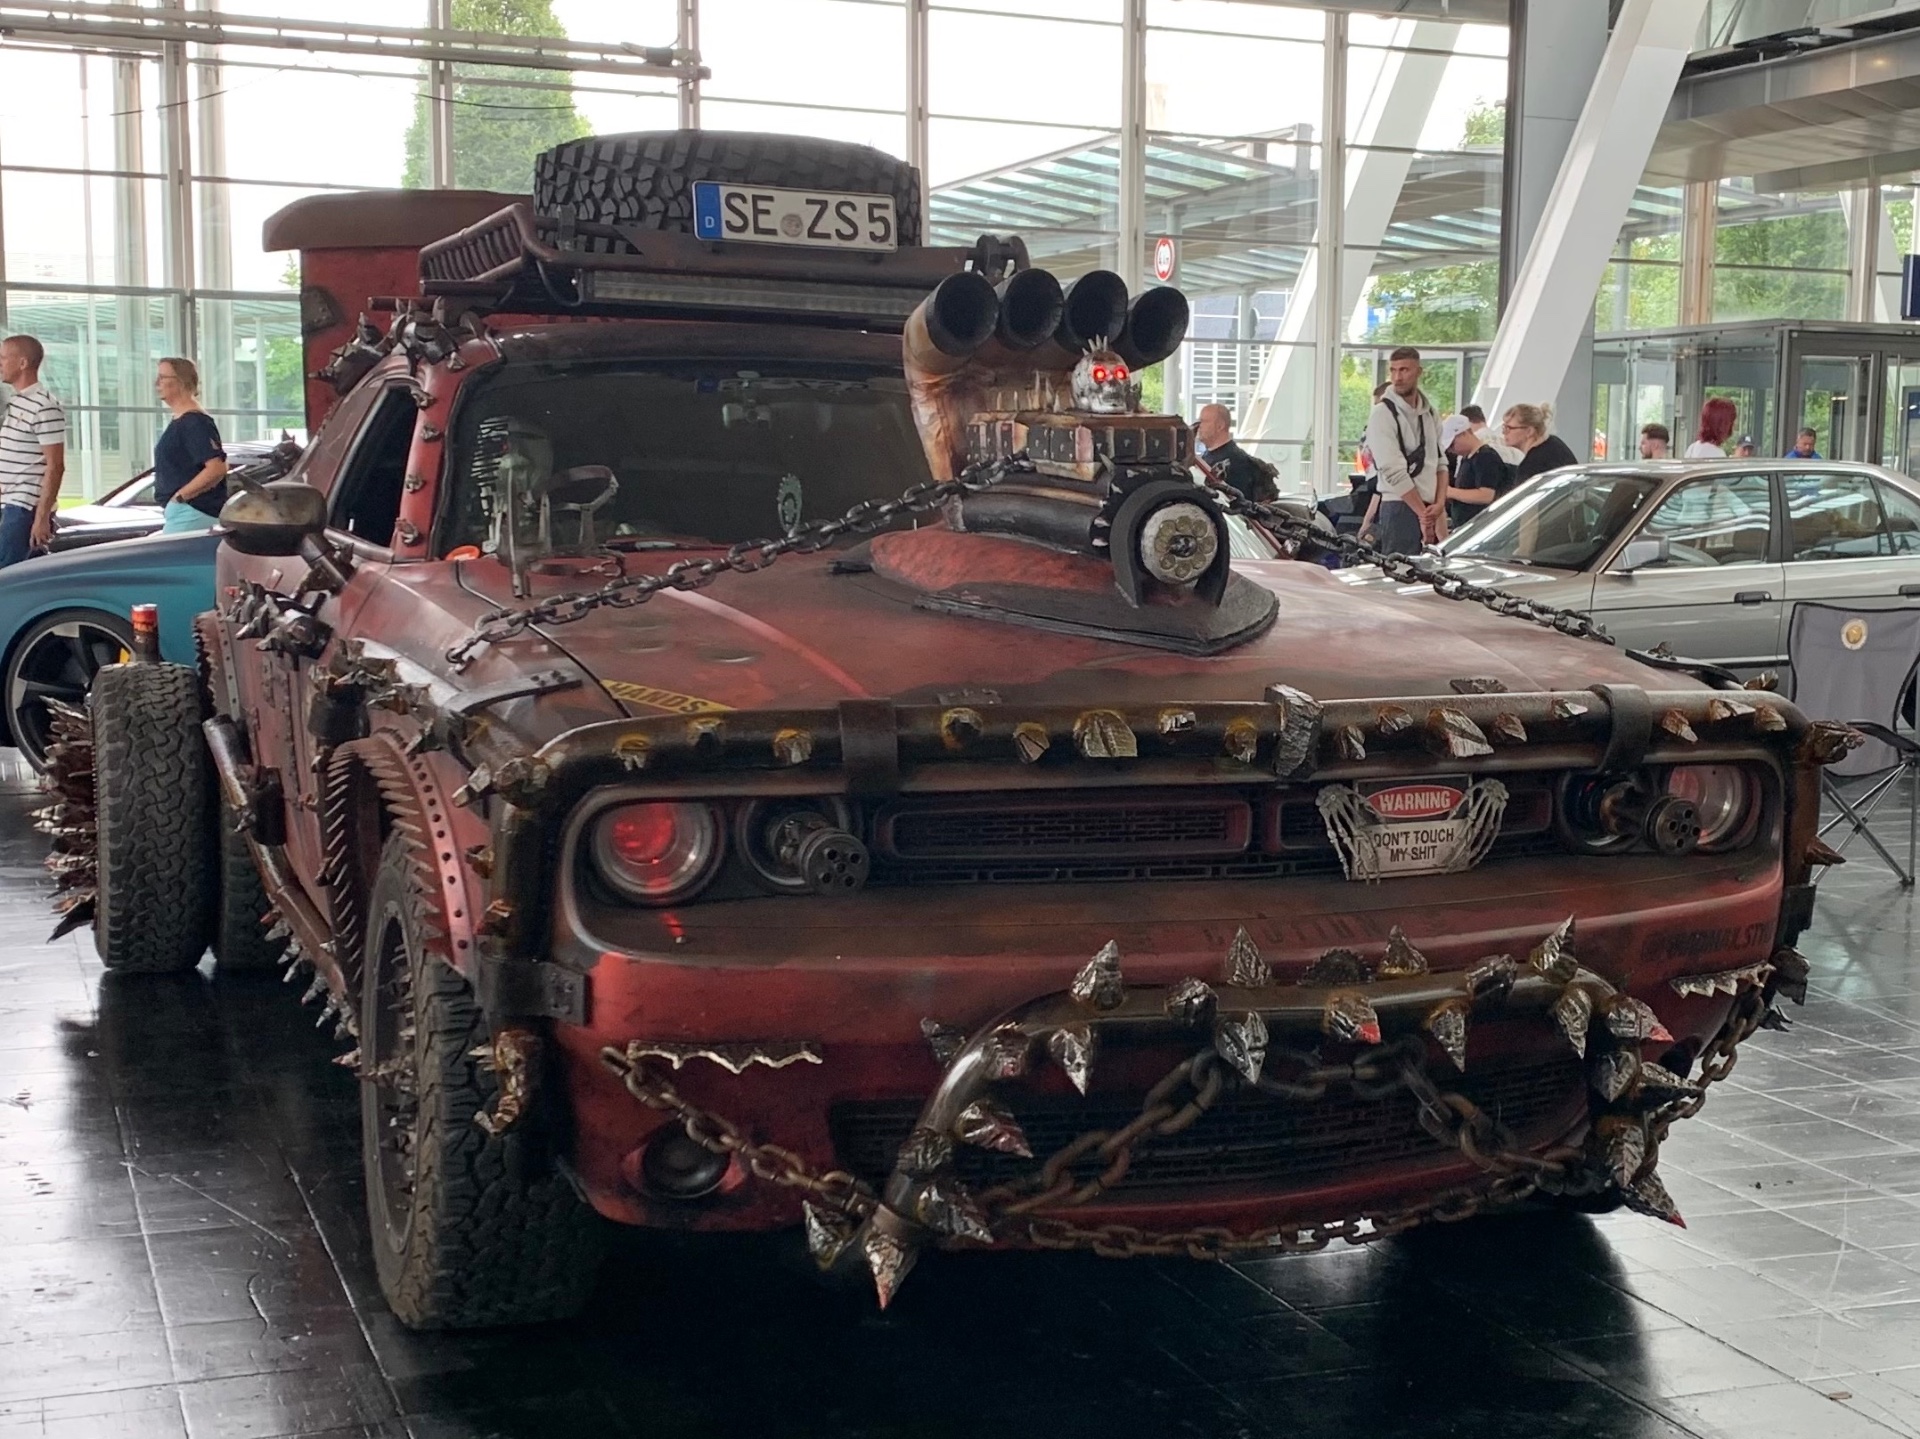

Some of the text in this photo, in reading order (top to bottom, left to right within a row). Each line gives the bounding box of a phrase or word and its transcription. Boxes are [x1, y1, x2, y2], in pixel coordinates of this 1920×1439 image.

[705, 216, 715, 229] D
[724, 192, 778, 236] SE
[609, 683, 708, 713] HANDS
[1378, 790, 1451, 812] WARNING
[1374, 828, 1454, 847] DON'T TOUCH
[1390, 845, 1438, 862] MY SHIT
